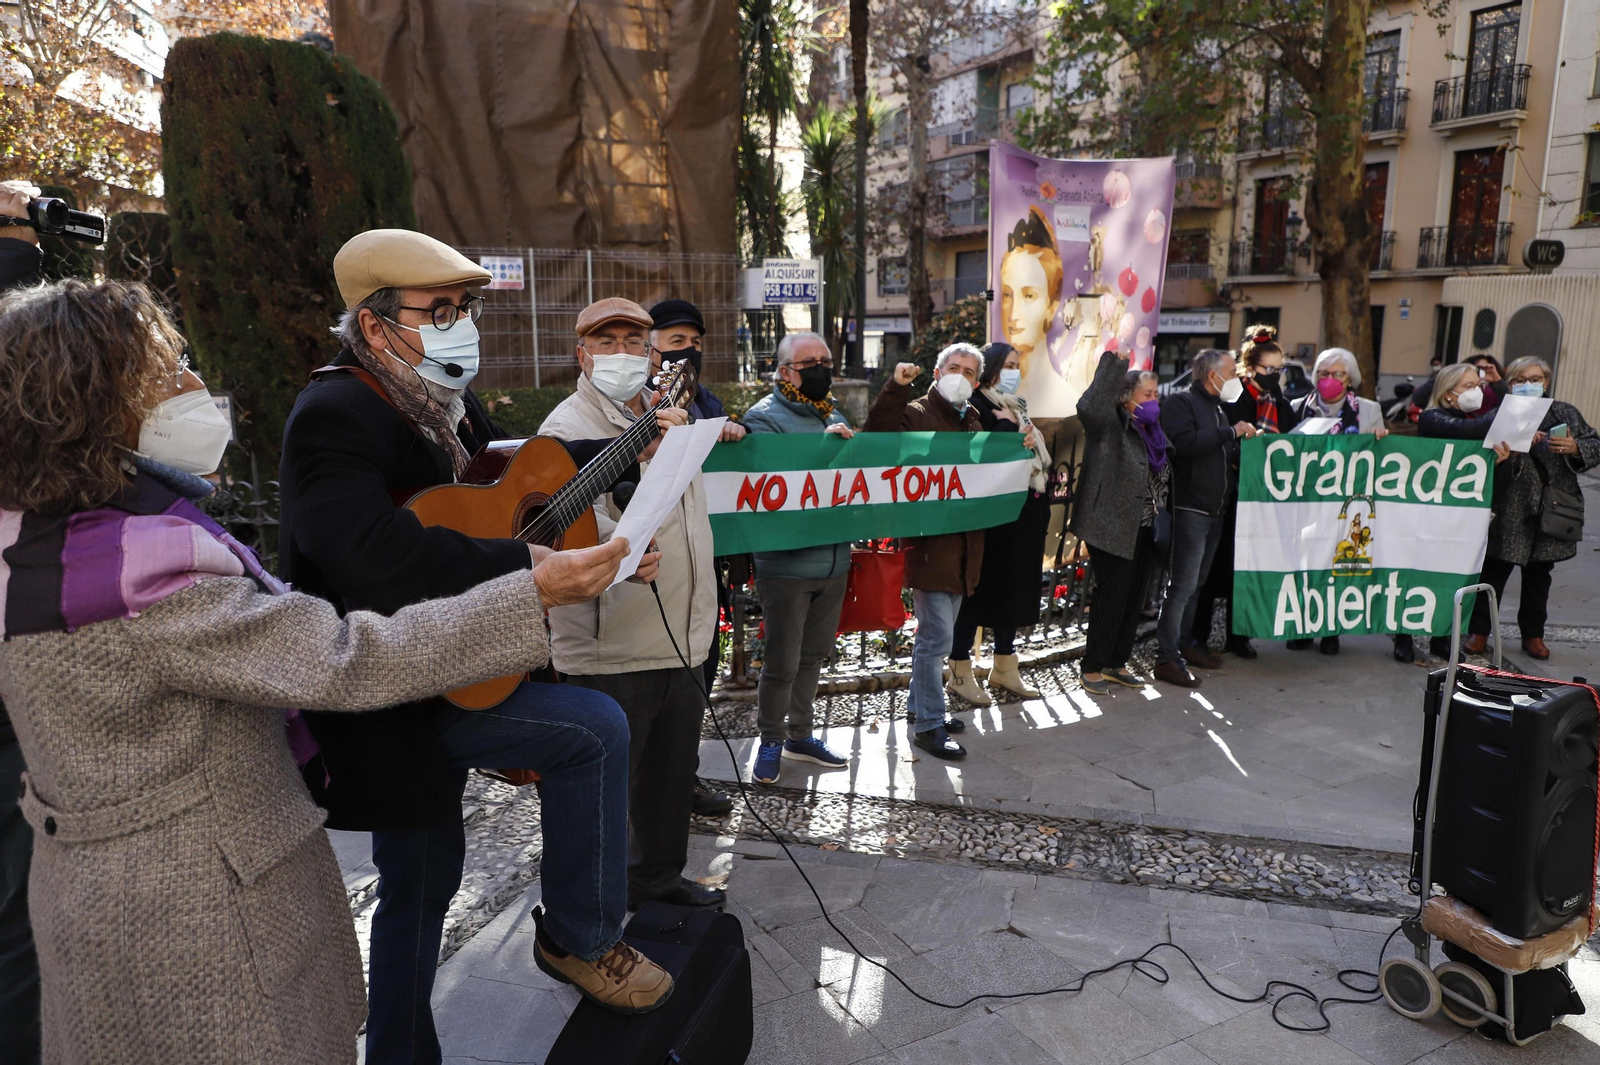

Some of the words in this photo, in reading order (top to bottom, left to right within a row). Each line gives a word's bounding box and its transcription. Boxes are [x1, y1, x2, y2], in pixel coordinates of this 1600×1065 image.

[1057, 187, 1082, 202] Granada
[1083, 189, 1104, 204] Abierta
[1537, 245, 1557, 262] WC
[765, 284, 780, 297] 958
[782, 284, 793, 297] 42
[794, 284, 804, 297] 01
[806, 284, 817, 297] 45
[1171, 318, 1207, 326] Tributario
[153, 431, 172, 440] KN95
[1264, 439, 1487, 503] Granada
[736, 473, 787, 512] NO
[800, 471, 819, 510] A
[831, 469, 870, 507] LA
[881, 466, 965, 503] TOMA
[1274, 571, 1436, 636] Abierta
